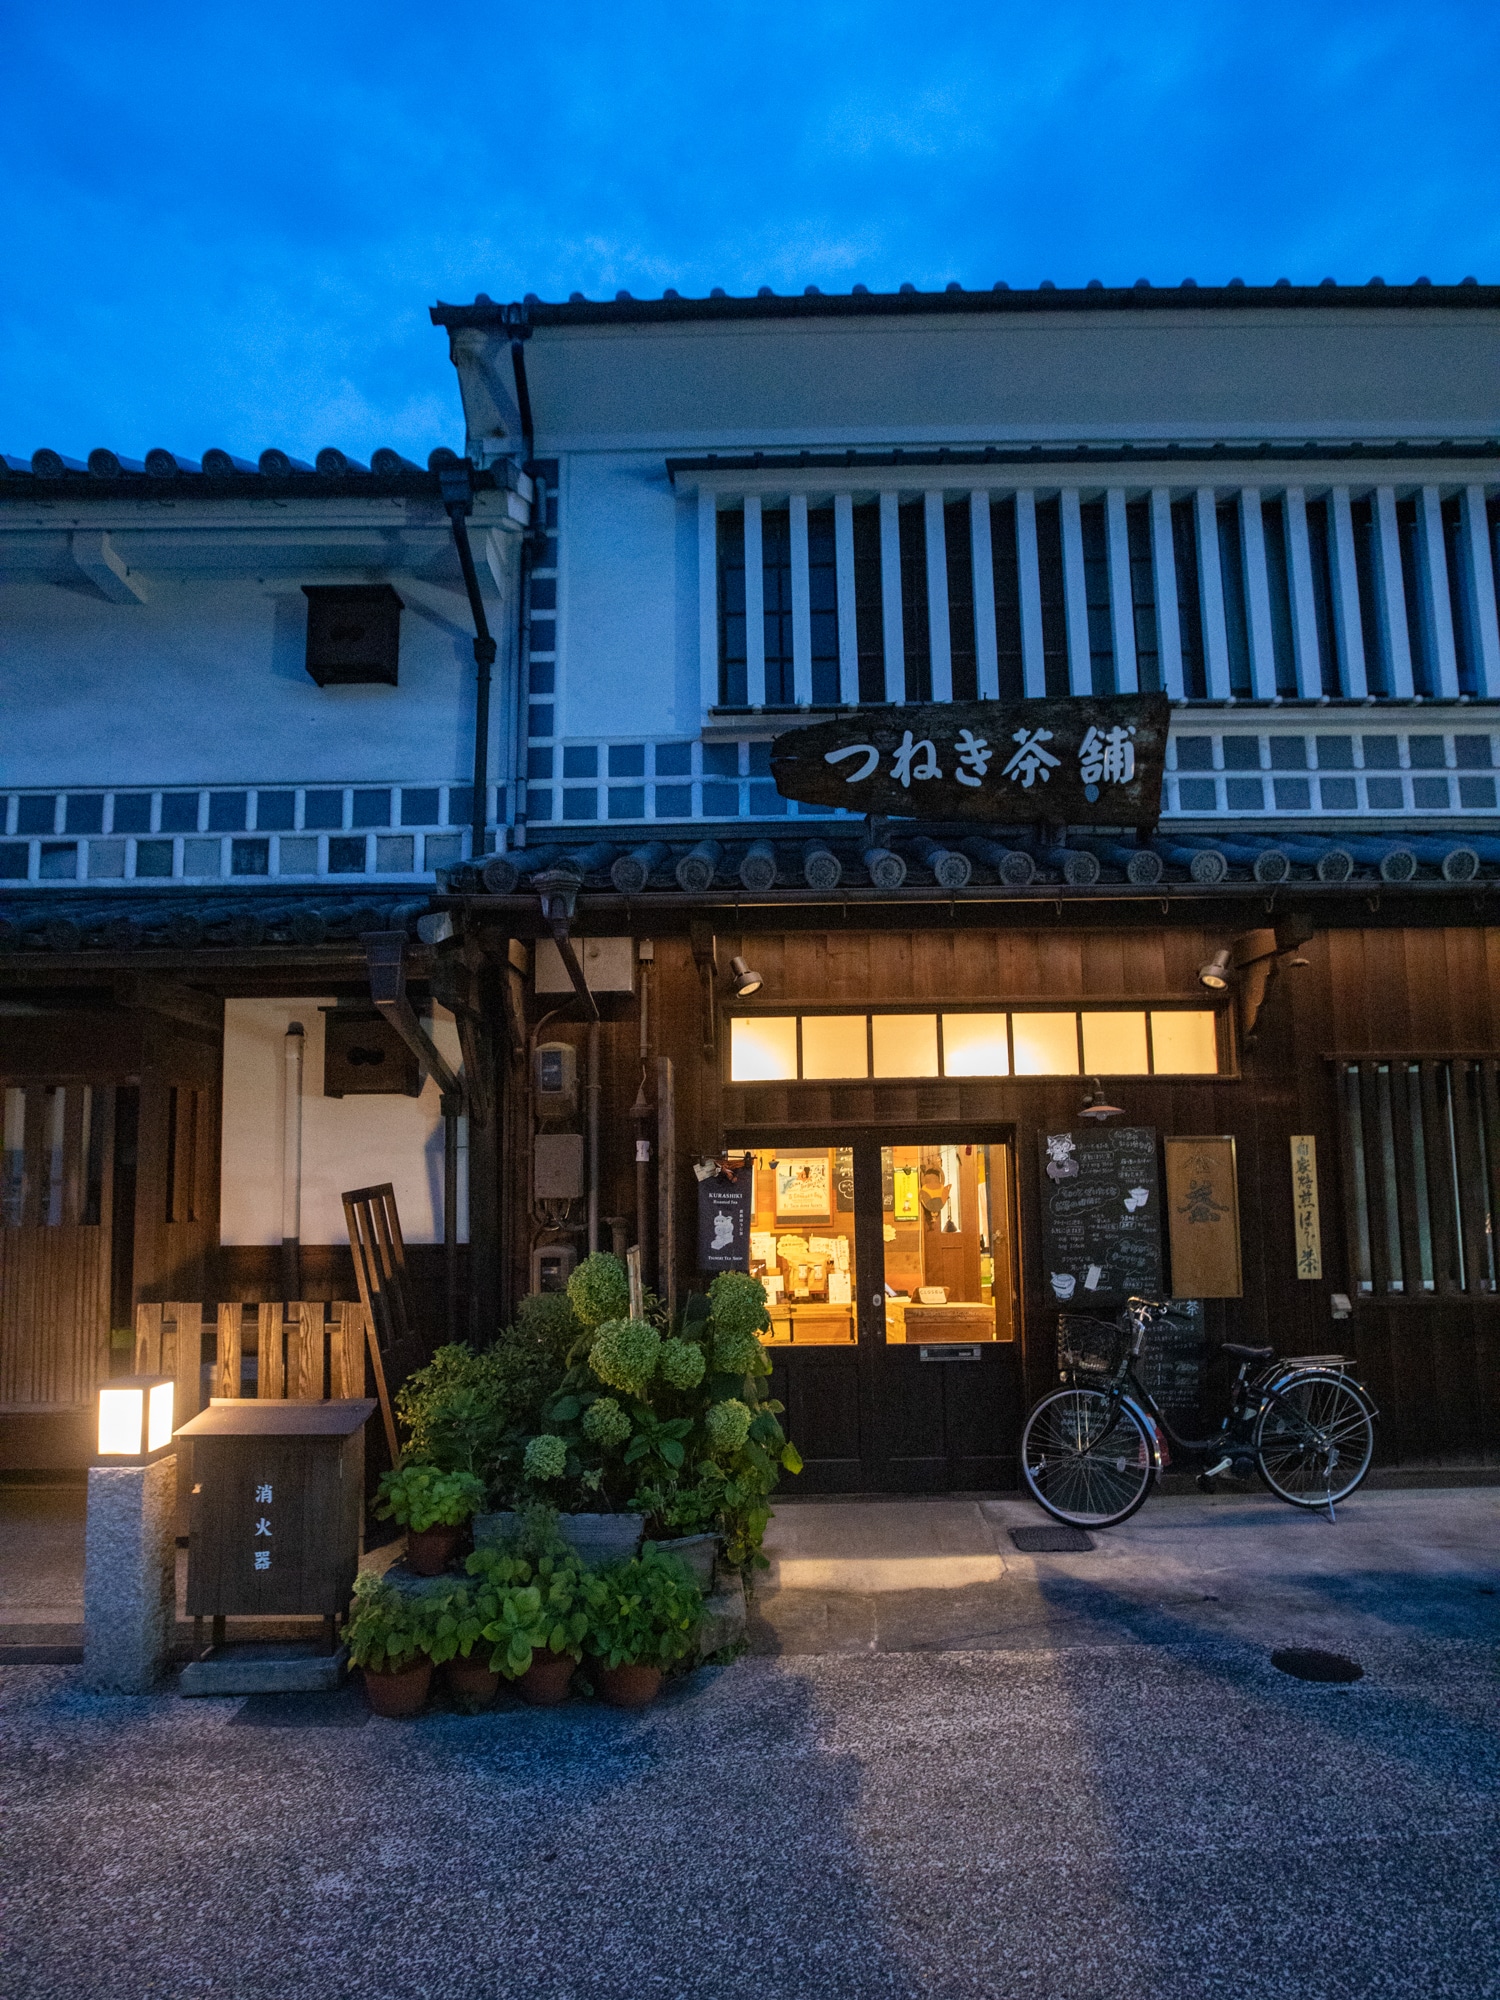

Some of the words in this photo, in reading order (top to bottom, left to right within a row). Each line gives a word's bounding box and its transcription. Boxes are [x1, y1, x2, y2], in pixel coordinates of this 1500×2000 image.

[824, 725, 1136, 788] つねき茶舗
[1295, 1143, 1318, 1273] 自家焙煎ほうじ茶
[254, 1484, 273, 1571] 消火器
